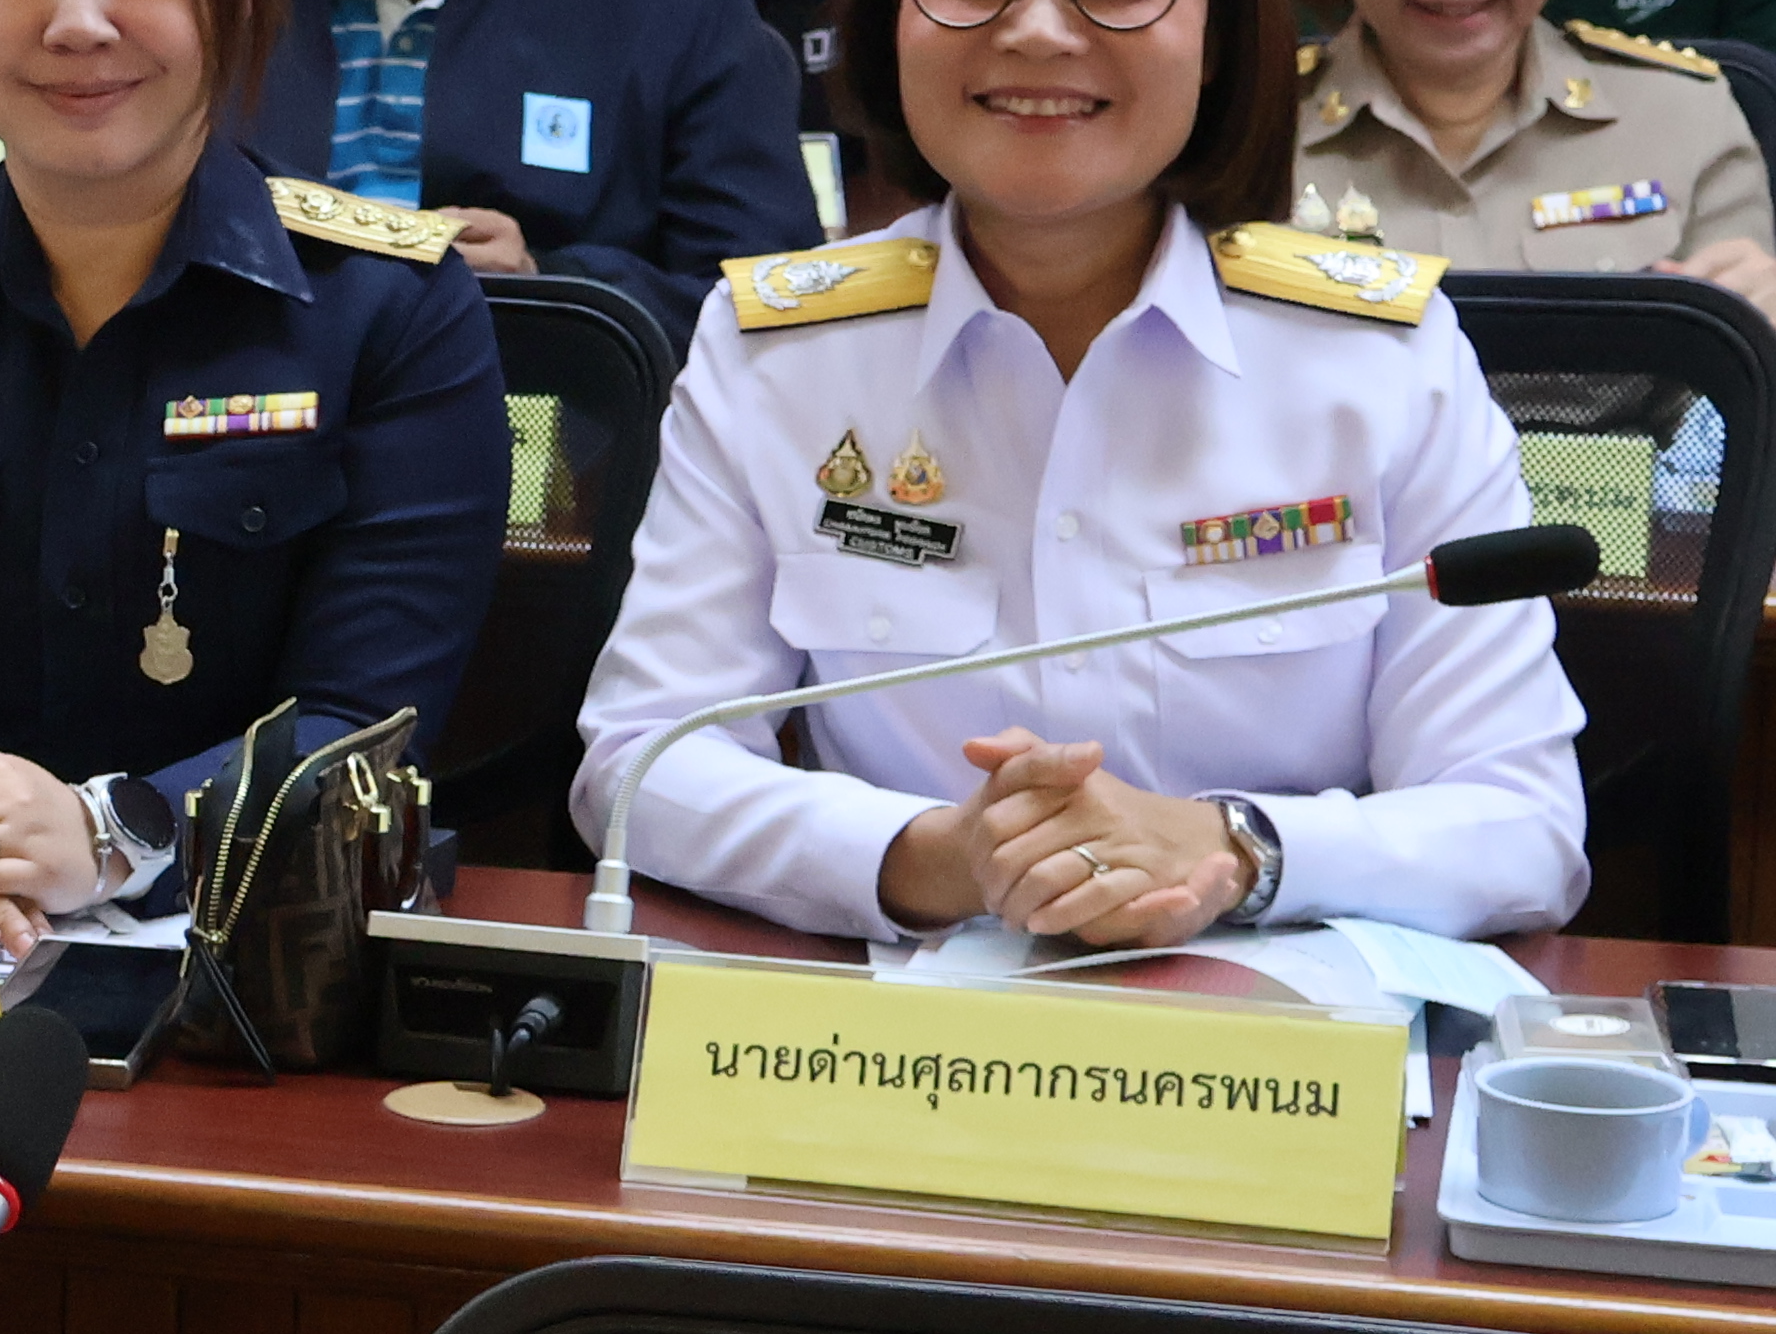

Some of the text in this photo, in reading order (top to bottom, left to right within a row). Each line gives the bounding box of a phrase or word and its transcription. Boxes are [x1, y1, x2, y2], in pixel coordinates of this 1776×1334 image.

[704, 1033, 1341, 1117] นายด่านศุลกากรนครพนม
